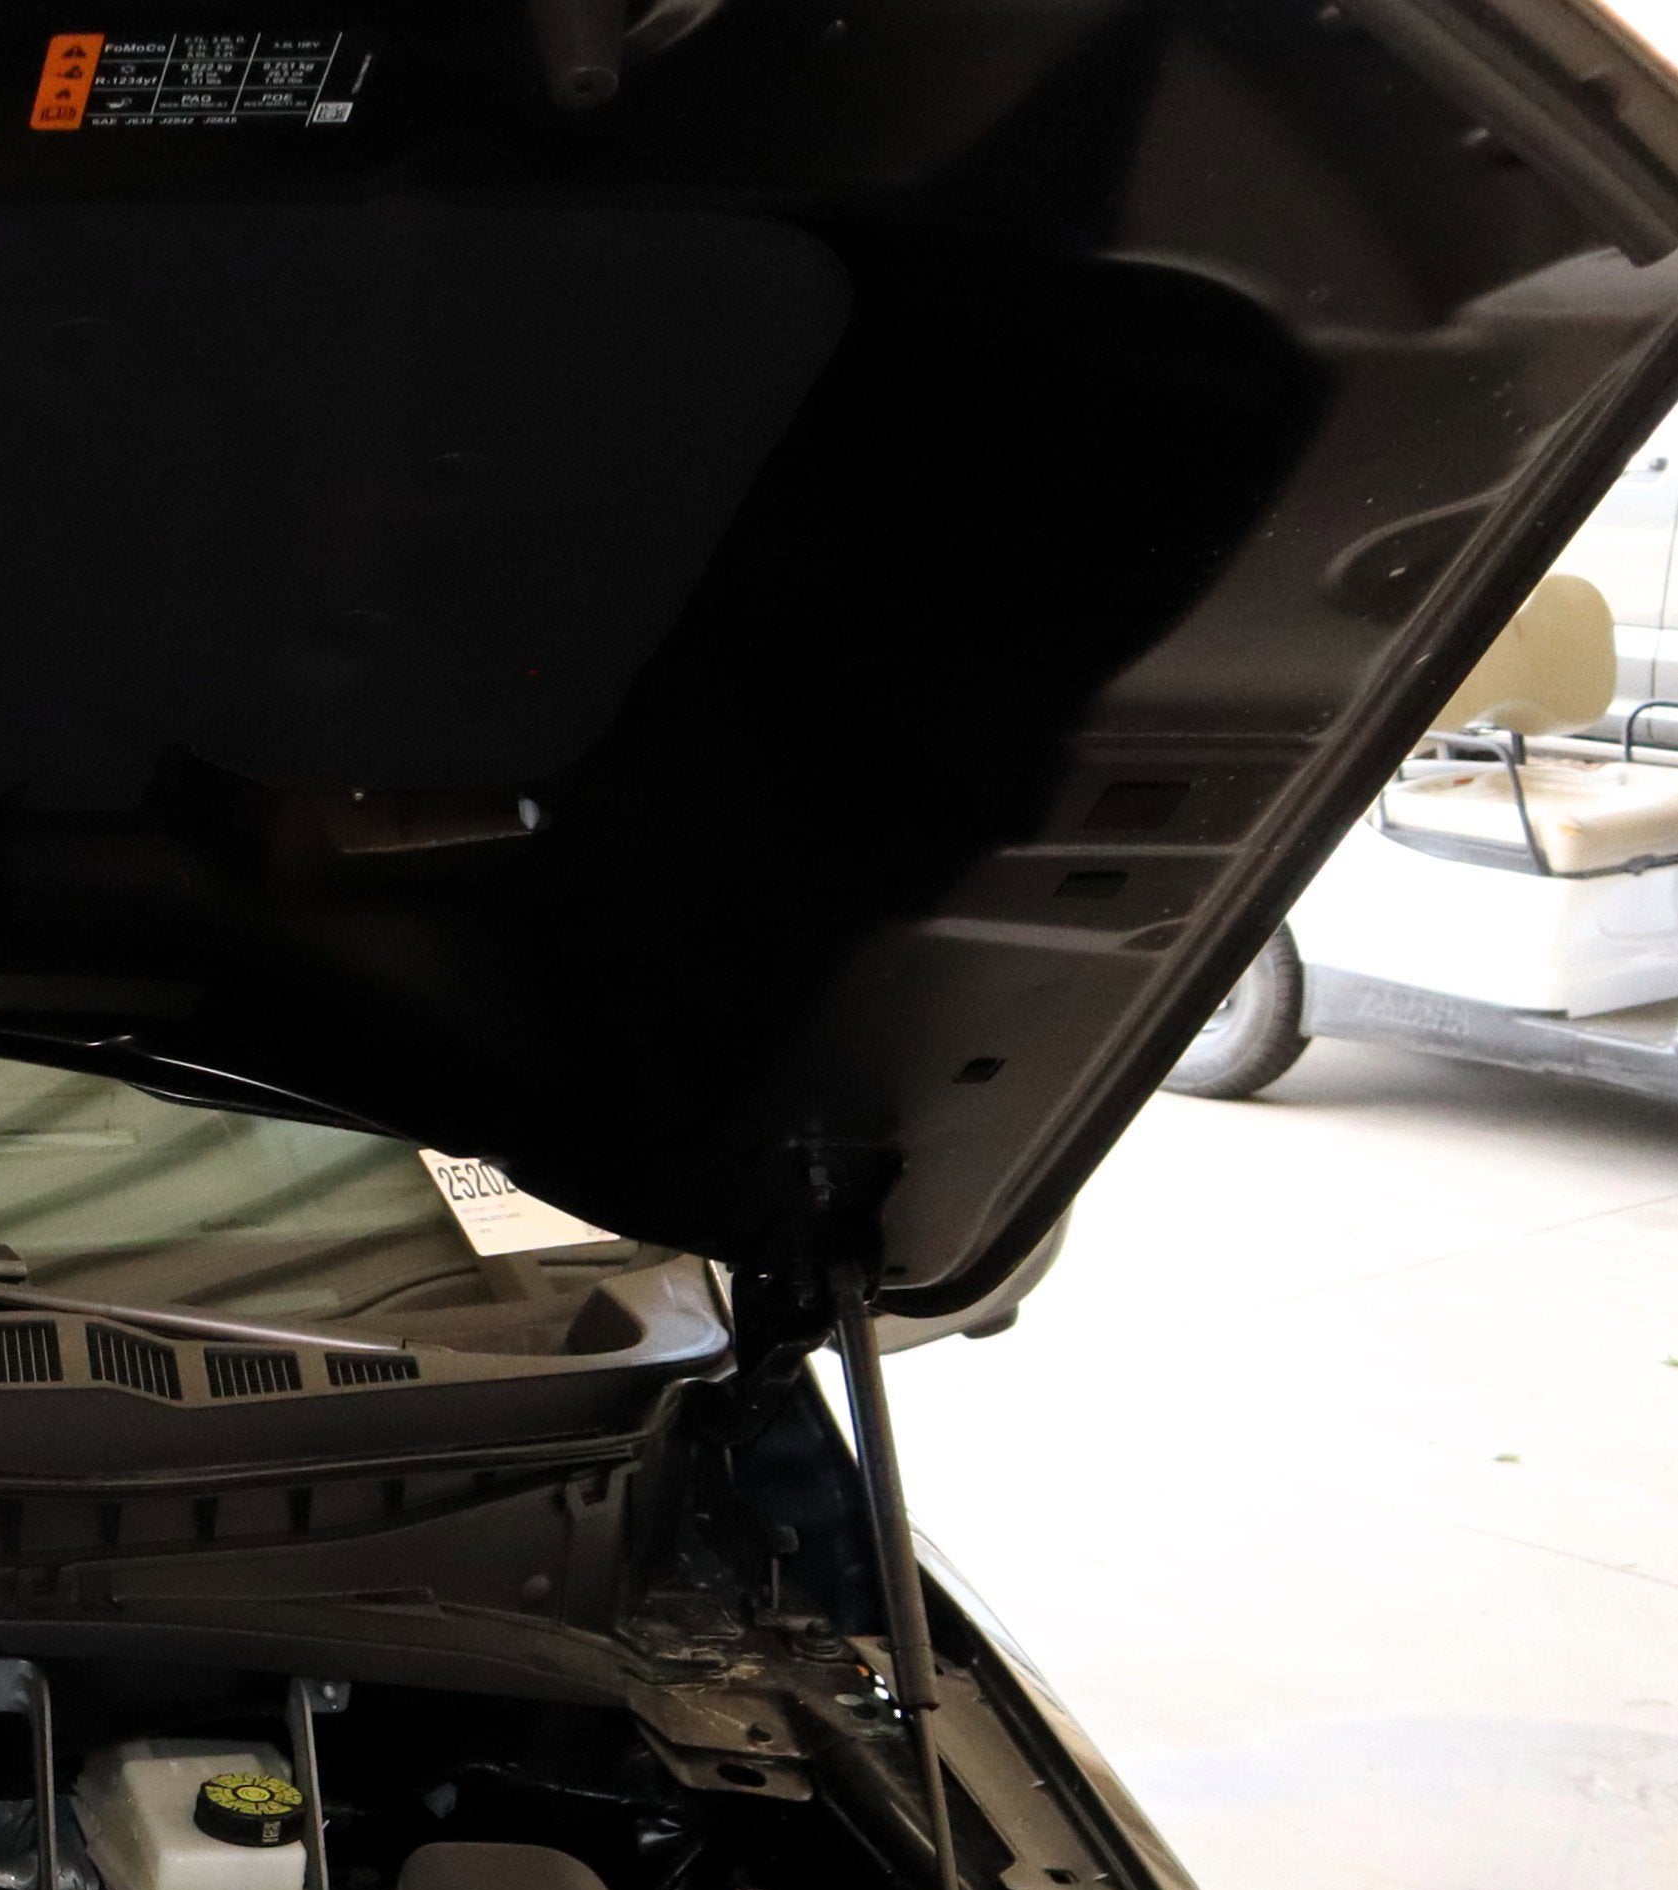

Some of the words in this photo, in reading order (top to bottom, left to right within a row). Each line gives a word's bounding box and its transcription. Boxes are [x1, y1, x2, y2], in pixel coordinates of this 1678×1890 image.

[105, 43, 166, 53] FoMoCo
[216, 62, 233, 73] kg
[298, 62, 315, 72] kg
[95, 76, 158, 87] R-1234yf
